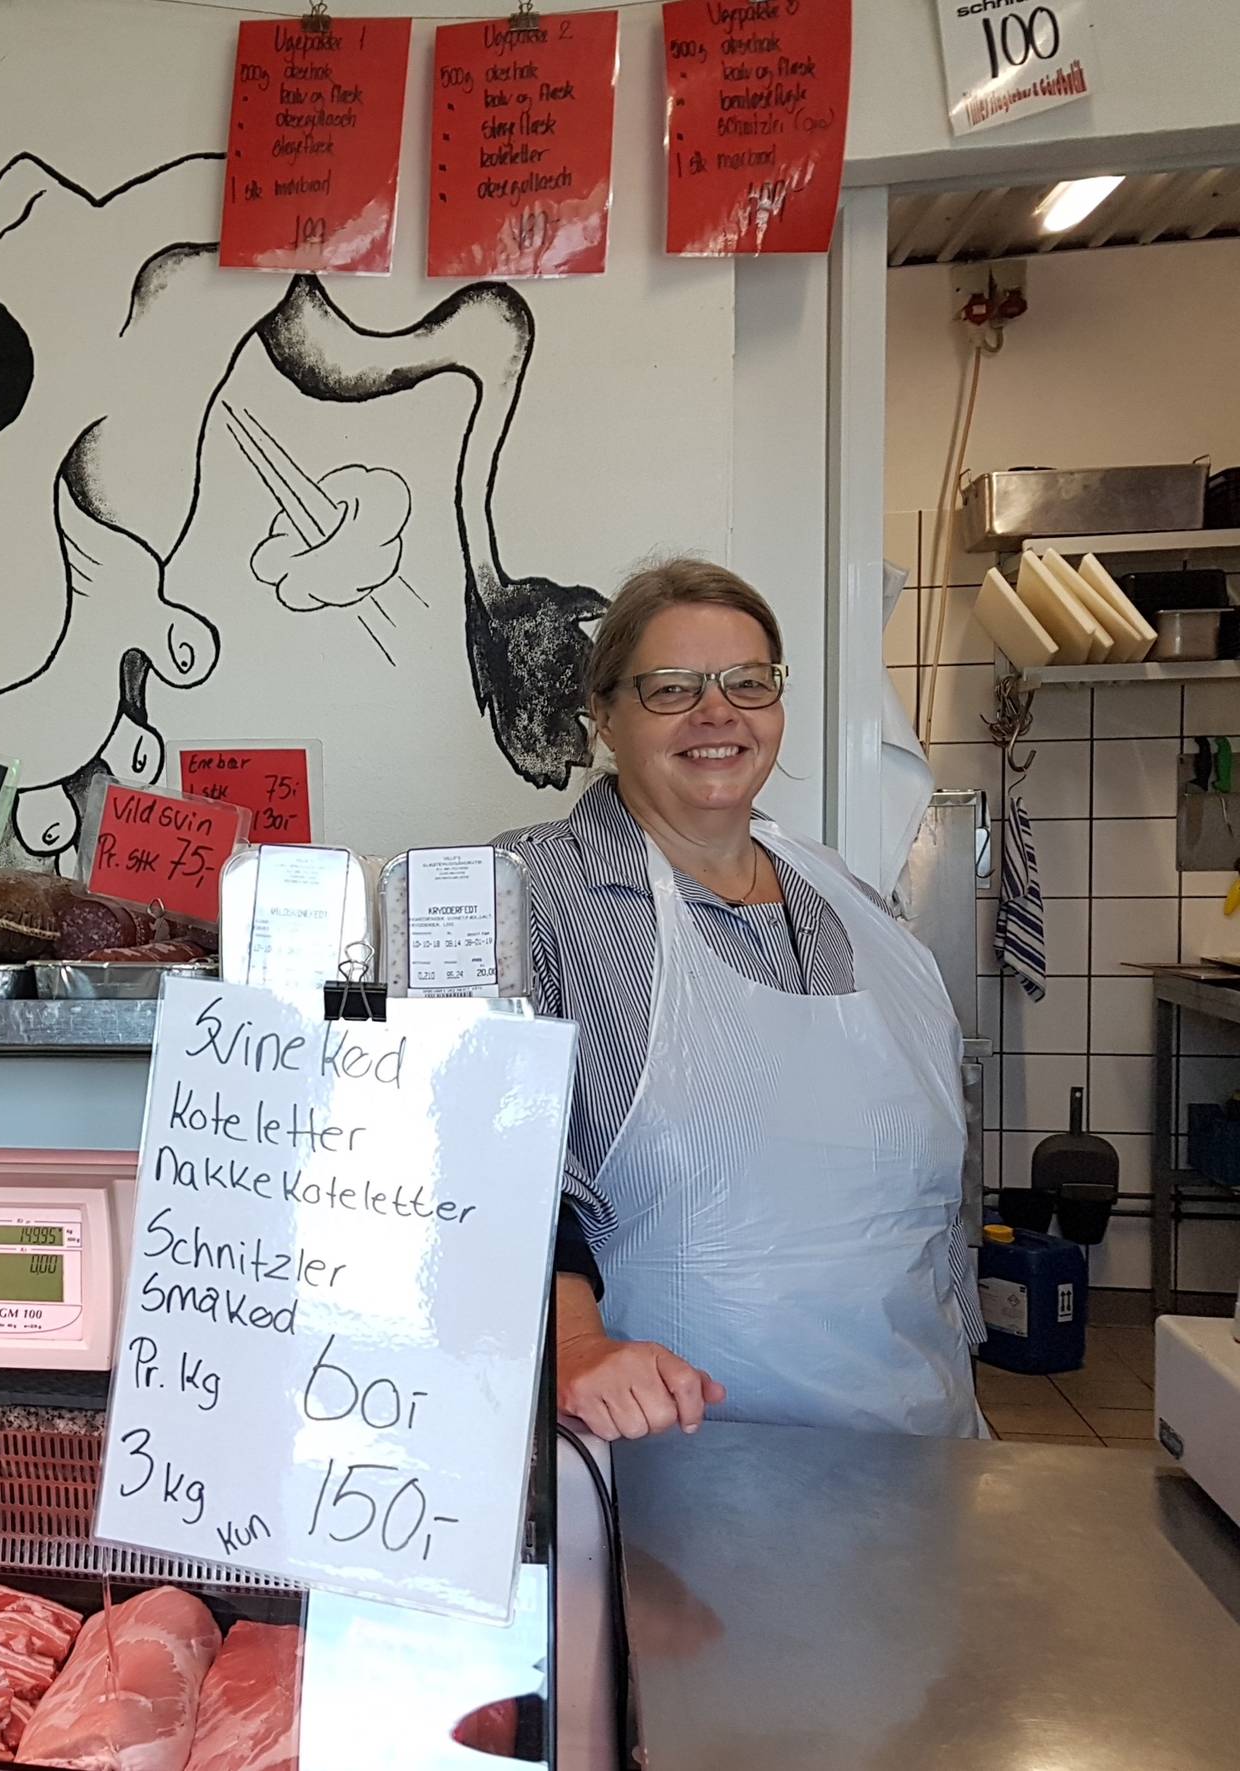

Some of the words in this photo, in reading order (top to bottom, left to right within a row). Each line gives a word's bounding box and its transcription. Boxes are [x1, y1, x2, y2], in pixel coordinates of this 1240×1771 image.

[982, 7, 1059, 79] 100
[144, 1212, 347, 1288] Schnitzler
[0, 1308, 19, 1319] GM
[23, 1309, 42, 1319] 100
[120, 1428, 154, 1497] 3
[308, 1458, 459, 1561] 150,-
